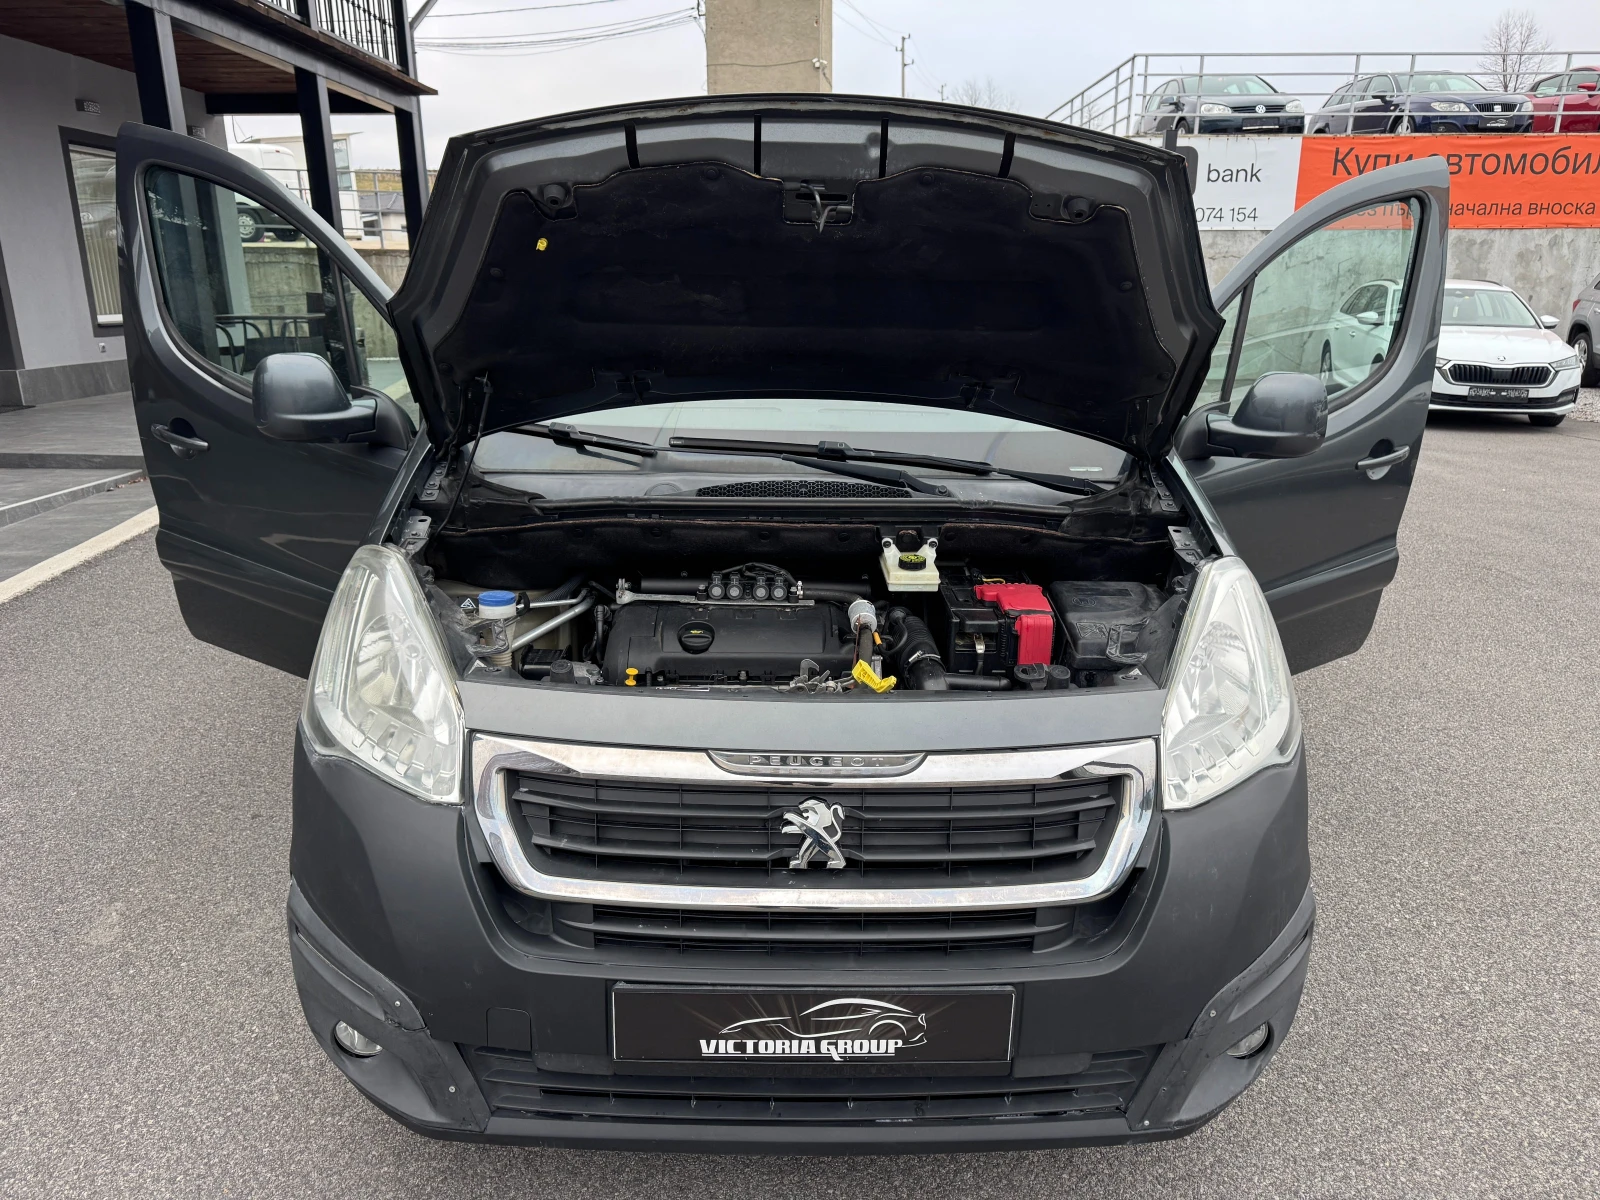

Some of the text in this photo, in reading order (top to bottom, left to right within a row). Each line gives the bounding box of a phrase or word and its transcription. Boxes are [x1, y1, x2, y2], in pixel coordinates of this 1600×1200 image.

[1207, 163, 1262, 182] bank
[1195, 207, 1259, 222] 074 154
[1528, 202, 1596, 215] вноска
[749, 755, 885, 767] PEUGEOT
[699, 1039, 904, 1061] VICTORIA GROUP
